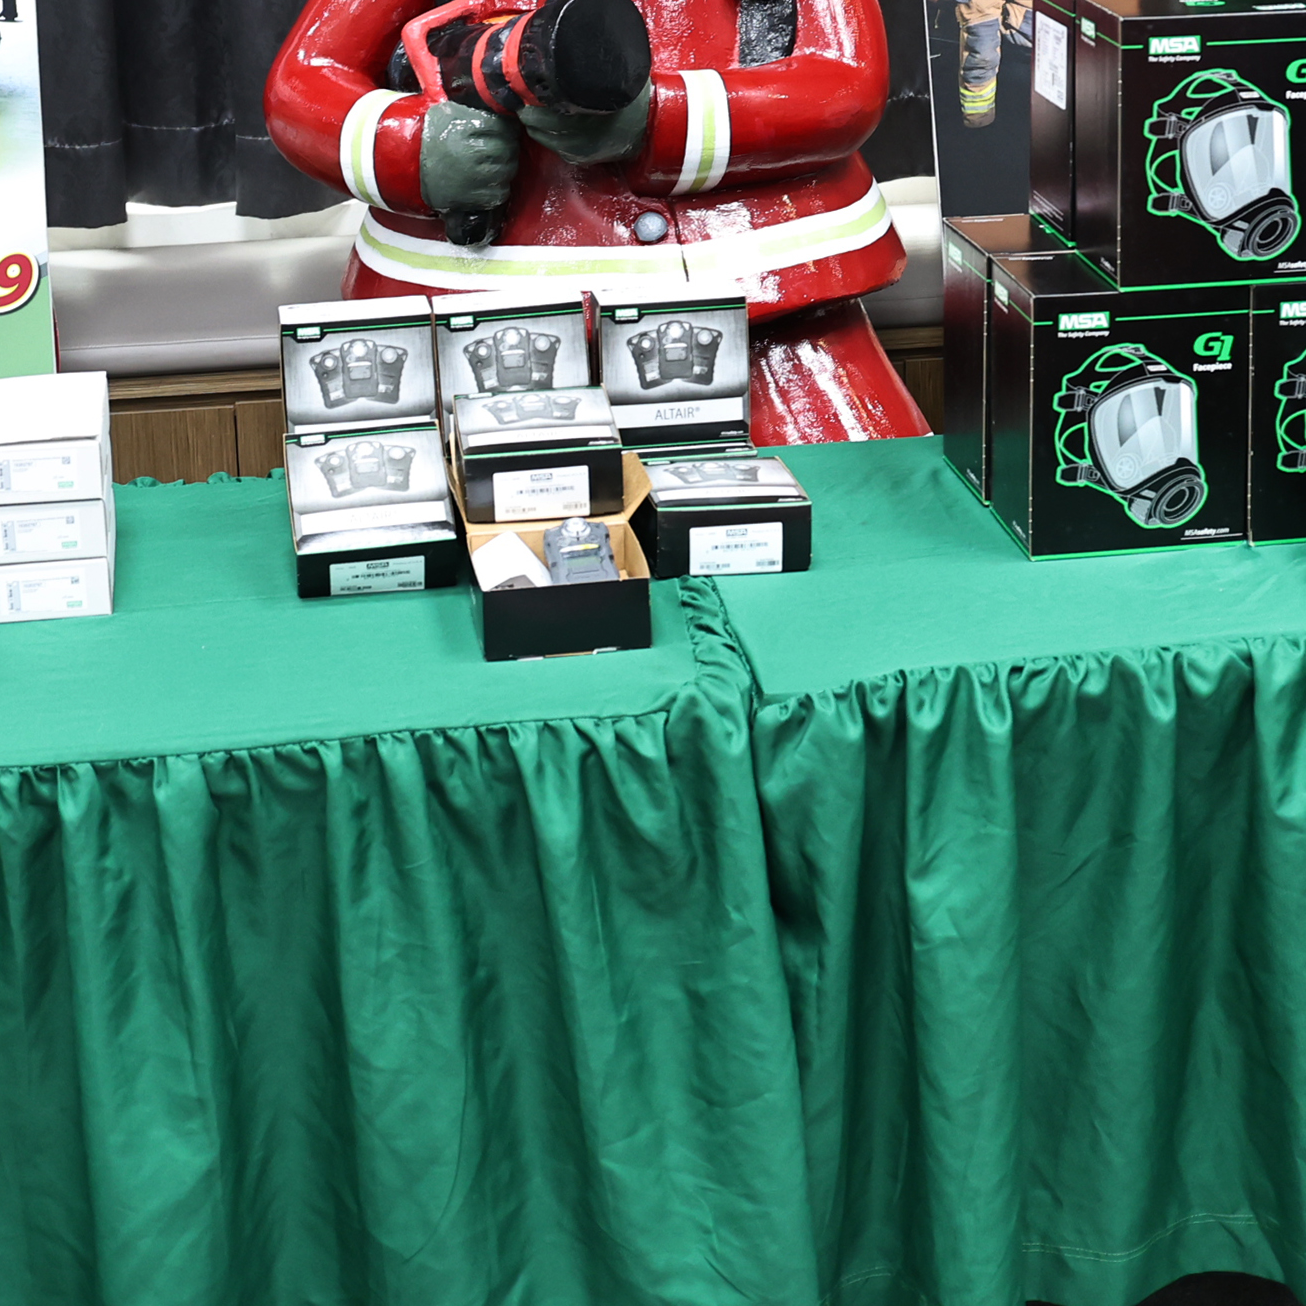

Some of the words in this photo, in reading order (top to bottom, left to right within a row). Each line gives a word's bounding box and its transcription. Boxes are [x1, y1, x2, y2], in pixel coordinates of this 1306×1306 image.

[1148, 35, 1202, 55] MSA
[1059, 311, 1110, 331] MSA
[1193, 332, 1234, 361] G1
[1193, 362, 1232, 372] Facepiece
